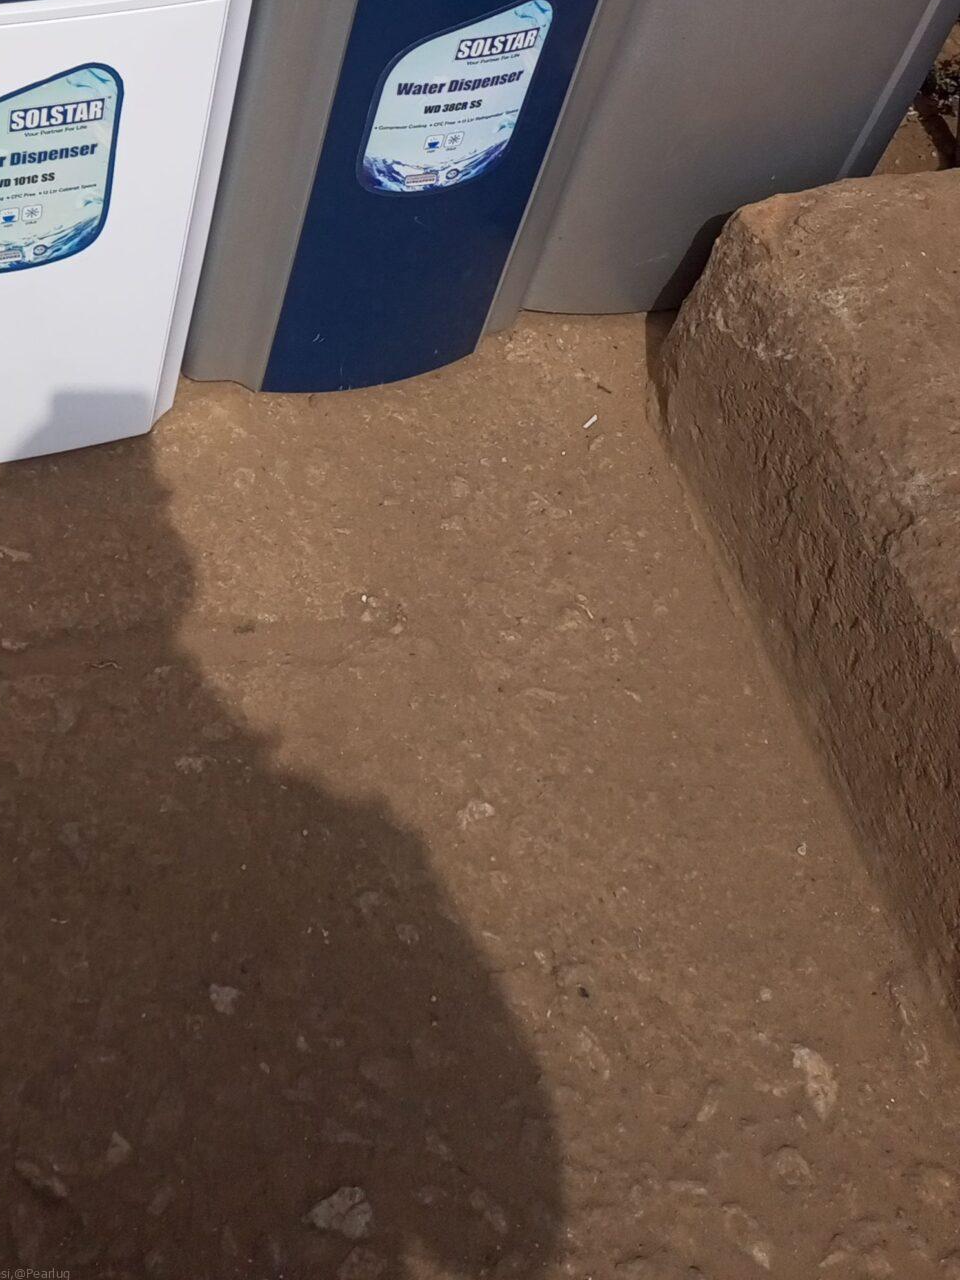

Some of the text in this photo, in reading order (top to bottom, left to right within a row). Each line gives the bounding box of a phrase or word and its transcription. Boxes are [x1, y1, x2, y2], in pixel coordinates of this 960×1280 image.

[456, 28, 539, 59] SOLSTAR
[396, 69, 525, 96] Water Dispenser
[10, 99, 104, 131] SOLSTAR
[423, 99, 483, 115] WD 38CR SS
[9, 143, 98, 166] Dispenser
[14, 175, 39, 186] 101C
[40, 172, 56, 182] SS
